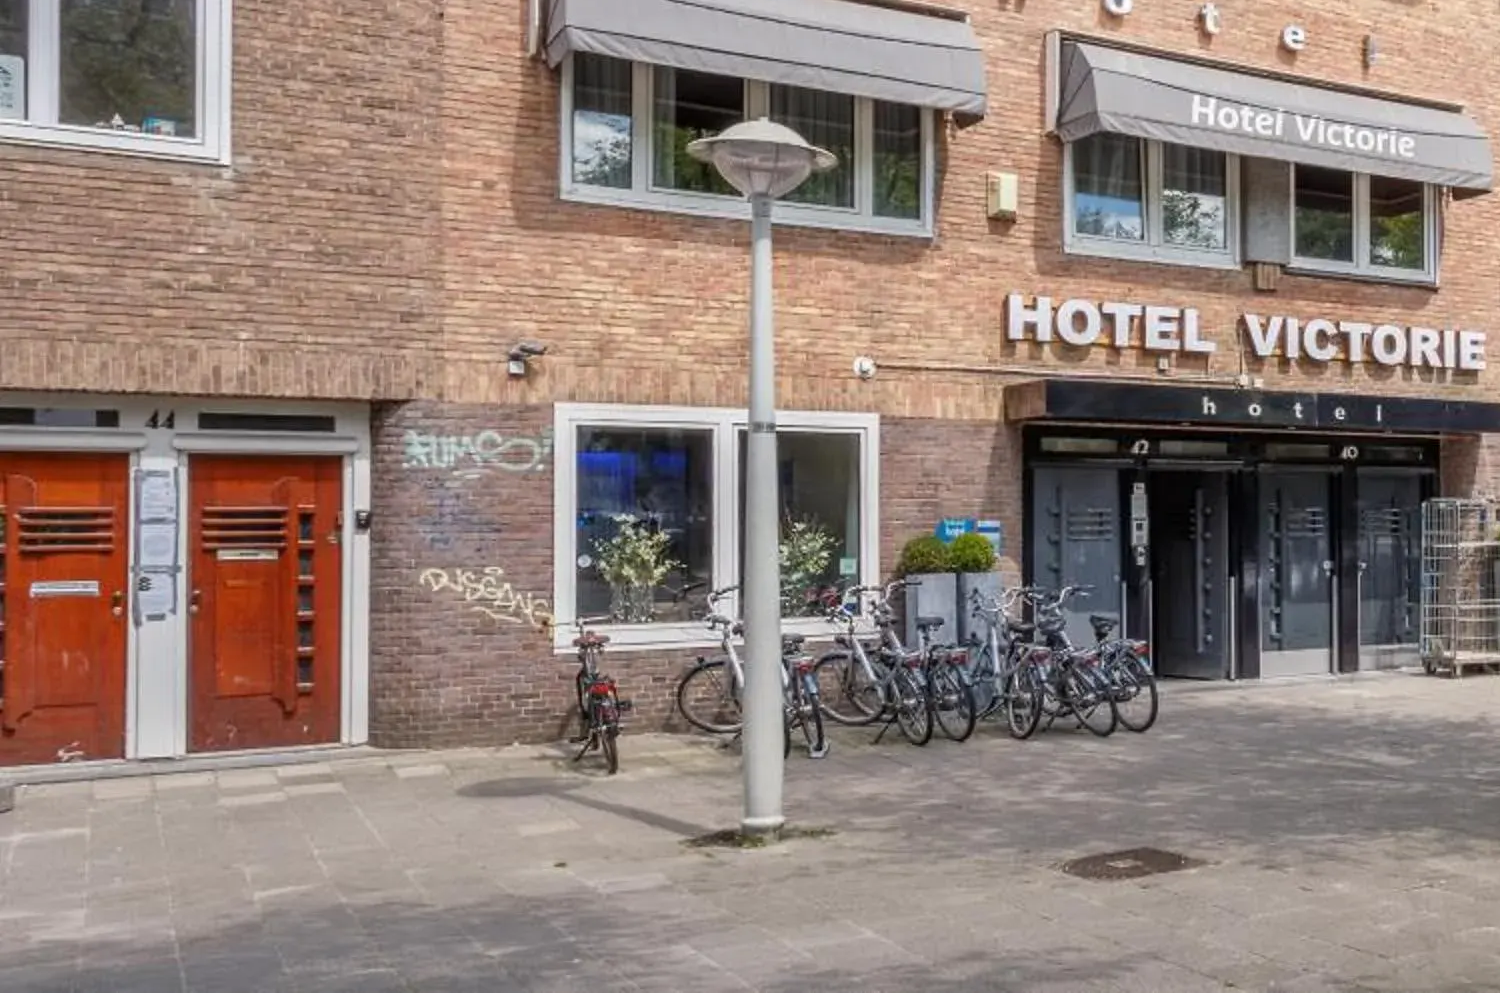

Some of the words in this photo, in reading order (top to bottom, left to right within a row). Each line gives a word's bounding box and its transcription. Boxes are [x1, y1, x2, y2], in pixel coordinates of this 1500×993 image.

[1191, 95, 1284, 137] Hotel
[1294, 113, 1416, 158] Victorie
[1007, 294, 1217, 353] HOTEL
[1244, 313, 1487, 370] VICTORIE
[144, 409, 176, 430] 44
[1202, 396, 1382, 422] hotel
[1131, 439, 1149, 454] 42
